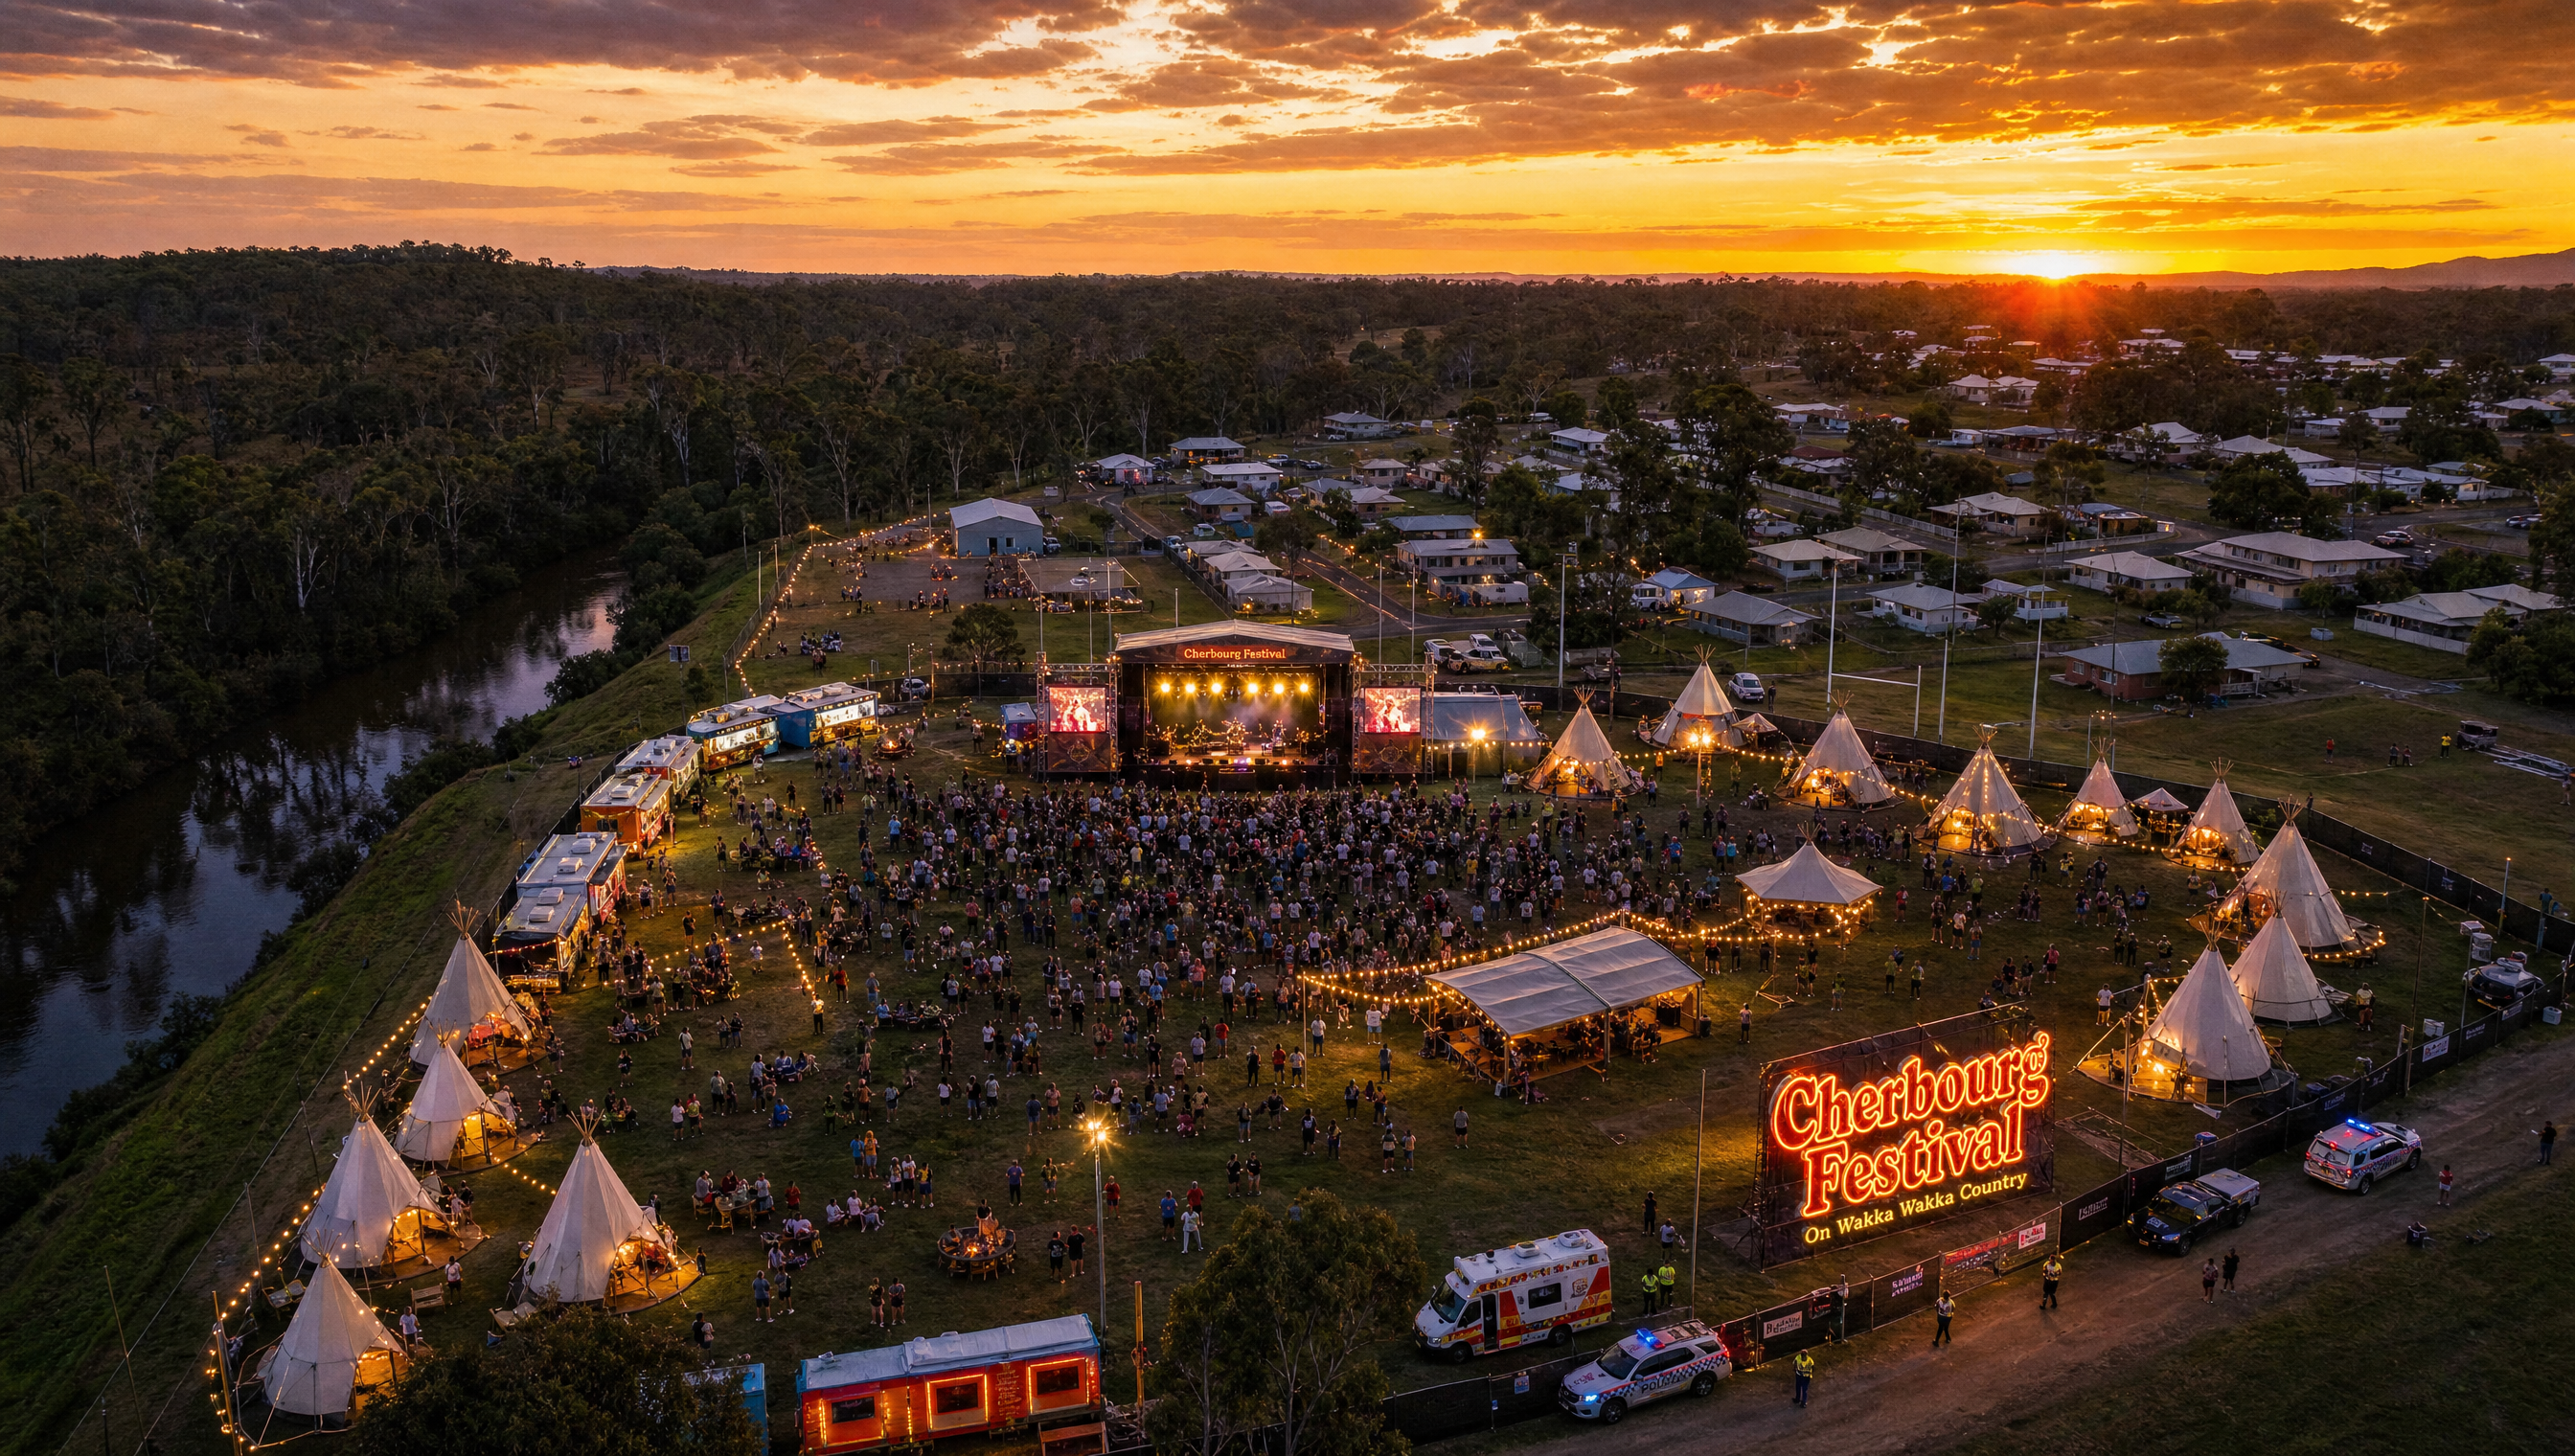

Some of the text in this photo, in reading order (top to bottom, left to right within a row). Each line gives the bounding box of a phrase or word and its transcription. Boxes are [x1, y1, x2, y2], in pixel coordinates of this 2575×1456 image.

[1184, 648, 1287, 660] Cherbourg Festival
[1770, 1030, 2050, 1150] Cherbourg
[1797, 1100, 2024, 1218] Festival
[1804, 1172, 2028, 1244] On Wakka Wakka Country
